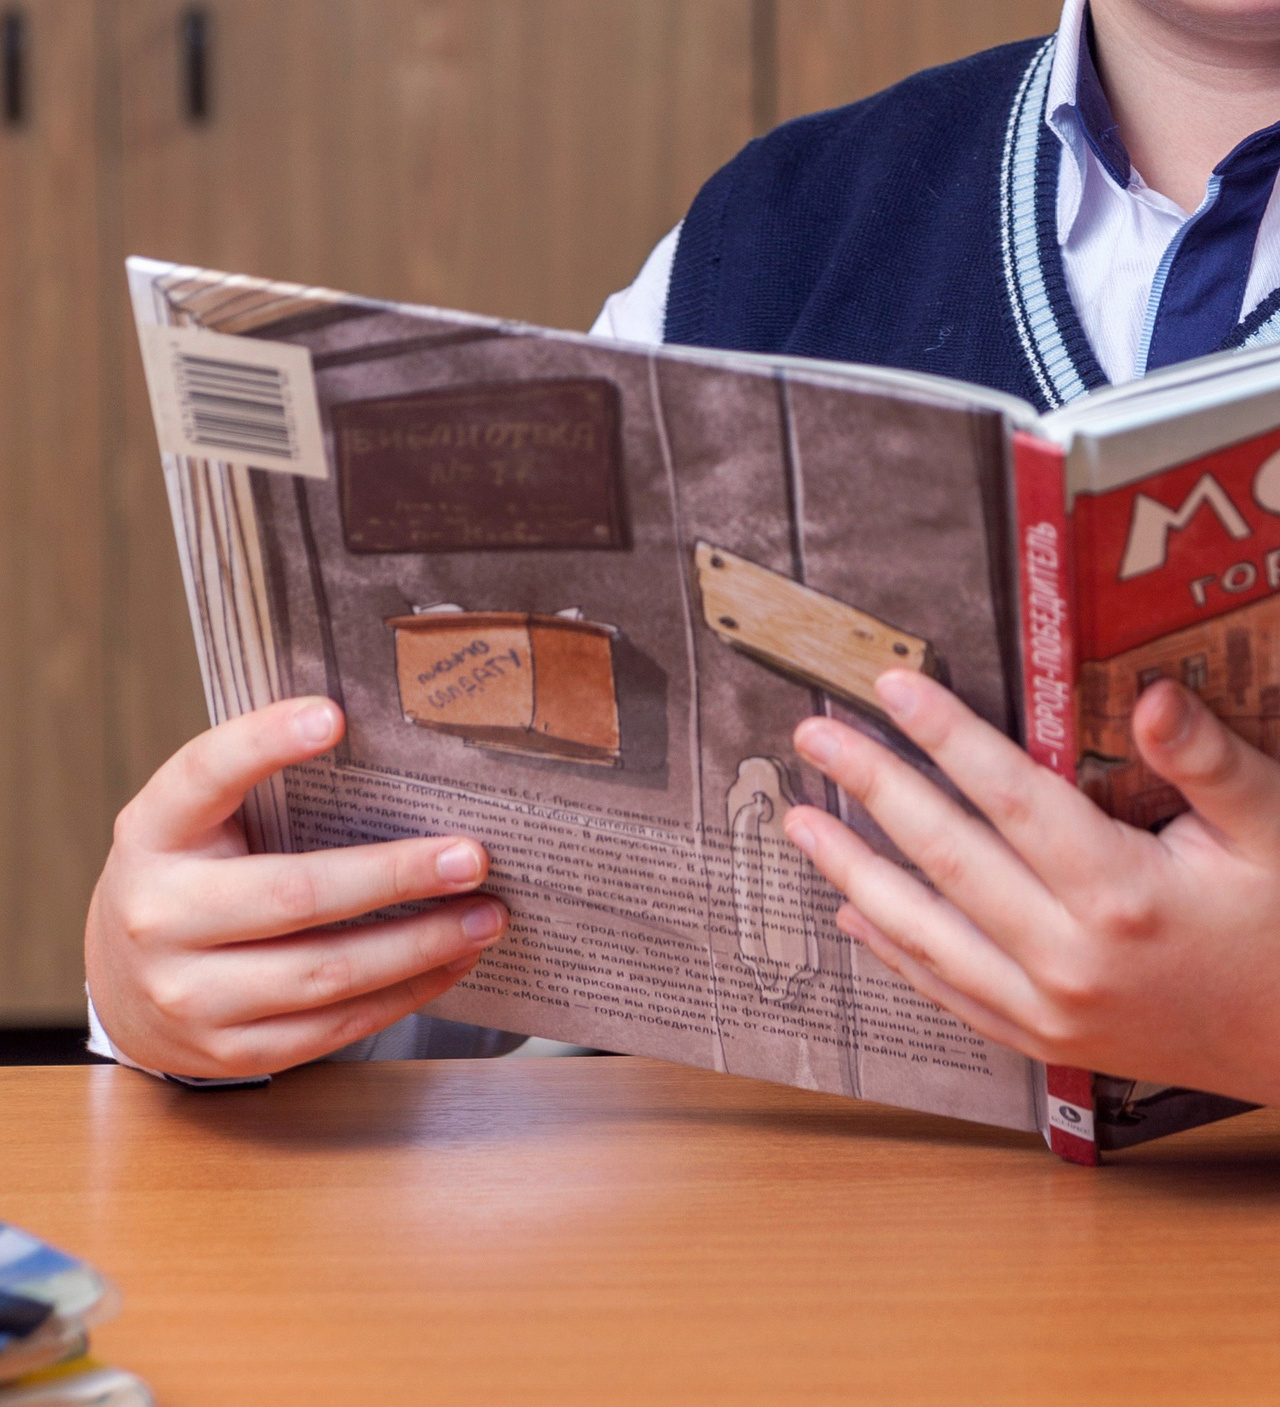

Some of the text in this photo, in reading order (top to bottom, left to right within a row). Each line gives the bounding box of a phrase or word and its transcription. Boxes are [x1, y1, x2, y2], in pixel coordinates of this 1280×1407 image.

[342, 773, 400, 790] рекламы
[406, 784, 451, 800] города
[457, 792, 509, 810] Москвы
[528, 805, 578, 823] Клубом
[583, 817, 645, 836] учителей
[652, 830, 694, 845] газеты
[370, 763, 399, 776] года
[405, 770, 495, 793] издательство
[607, 807, 679, 827] совместно
[361, 818, 419, 835] которым
[481, 840, 592, 868] соответствовать
[597, 862, 654, 879] издание
[671, 876, 711, 890] войне
[717, 884, 740, 895] для
[746, 889, 784, 904] детей
[365, 804, 426, 823] издатели
[444, 819, 532, 843] специалисты
[538, 837, 553, 847] по
[558, 841, 621, 861] детскому
[700, 867, 772, 887] результате
[382, 794, 442, 812] говорить
[458, 808, 506, 824] детьми
[595, 834, 666, 854] дискуссии
[672, 848, 729, 865] приняли
[735, 860, 788, 876] участие
[490, 856, 540, 872] должна
[546, 864, 579, 879] быть
[583, 873, 693, 901] познавательной
[534, 878, 582, 894] основе
[586, 888, 647, 906] рассказа
[652, 900, 702, 917] должна
[708, 911, 755, 927] лежать
[555, 895, 615, 914] контекст
[620, 907, 698, 929] глобальных
[521, 936, 584, 959] большие,
[601, 953, 679, 975] маленькие?
[685, 967, 725, 984] Какие
[801, 991, 816, 1001] их
[820, 995, 891, 1017] окружали,
[896, 1010, 911, 1020] на
[916, 1013, 957, 1028] каком
[542, 929, 576, 945] нашу
[581, 937, 638, 955] столицу.
[644, 946, 689, 964] Только
[694, 958, 709, 968] не
[733, 951, 790, 969] дневник
[795, 963, 860, 983] обычного
[475, 970, 531, 987] рассказ.
[547, 983, 568, 994] его
[573, 988, 619, 1004] героем
[624, 998, 642, 1009] мы
[648, 1003, 705, 1021] пройдем
[710, 1015, 739, 1027] путь
[743, 1021, 757, 1031] от
[762, 1025, 808, 1040] самого
[813, 1034, 859, 1050] начала
[864, 1044, 906, 1059] войны
[911, 1053, 927, 1063] до
[932, 1057, 992, 1077] момента,
[498, 947, 540, 962] жизни
[545, 956, 611, 976] нарушила
[629, 972, 702, 993] разрушила
[706, 987, 753, 1003] война?
[860, 1017, 918, 1036] машины,
[936, 1031, 984, 1047] многое
[512, 988, 569, 1008] «Москва
[533, 968, 549, 978] но
[566, 974, 650, 999] нарисовано,
[654, 991, 717, 1010] показано
[722, 1003, 737, 1013] на
[841, 1024, 867, 1038] При
[872, 1032, 903, 1045] этом
[908, 1039, 945, 1053] книга
[971, 1051, 987, 1061] не
